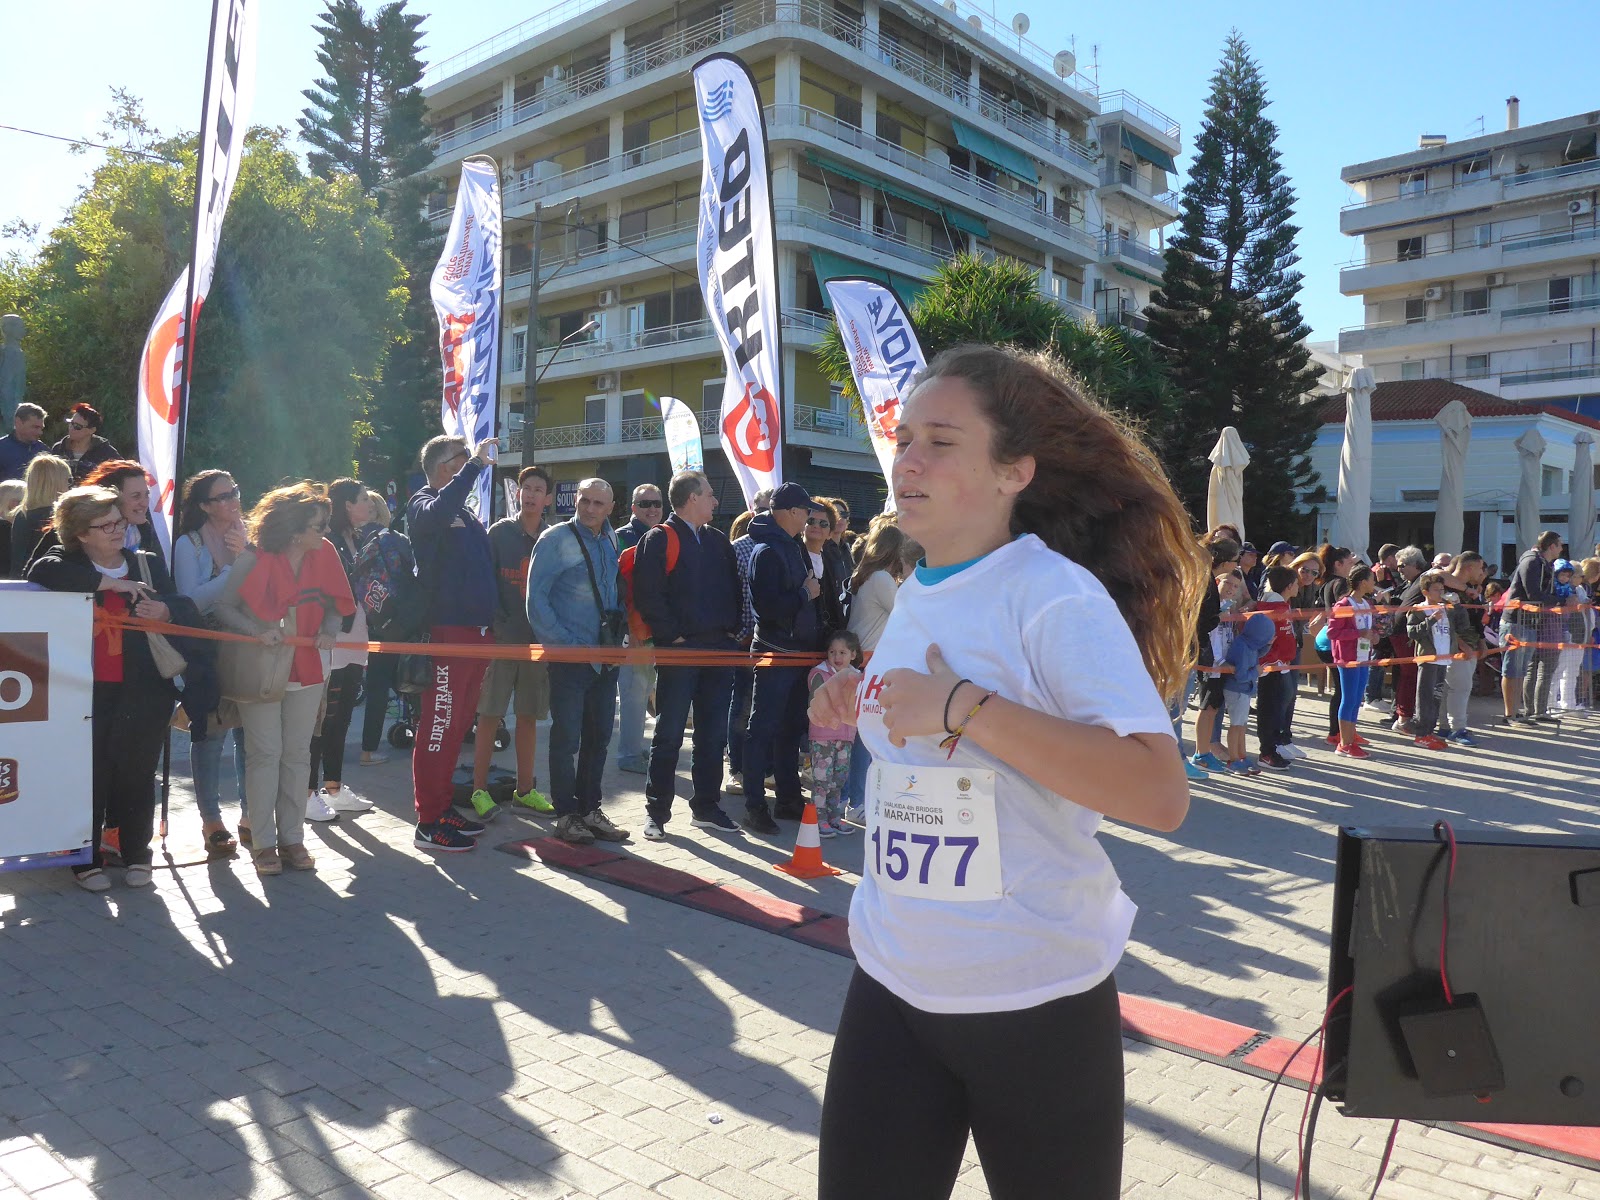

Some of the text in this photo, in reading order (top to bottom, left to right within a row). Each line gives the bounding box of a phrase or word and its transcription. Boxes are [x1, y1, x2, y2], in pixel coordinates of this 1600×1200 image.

[556, 492, 577, 507] SOUV
[428, 665, 449, 752] S.DRY TRACK
[884, 800, 906, 810] CHALKIDA
[916, 806, 943, 814] BRIDGES
[884, 808, 944, 826] MARATHON
[871, 825, 980, 887] 1577
